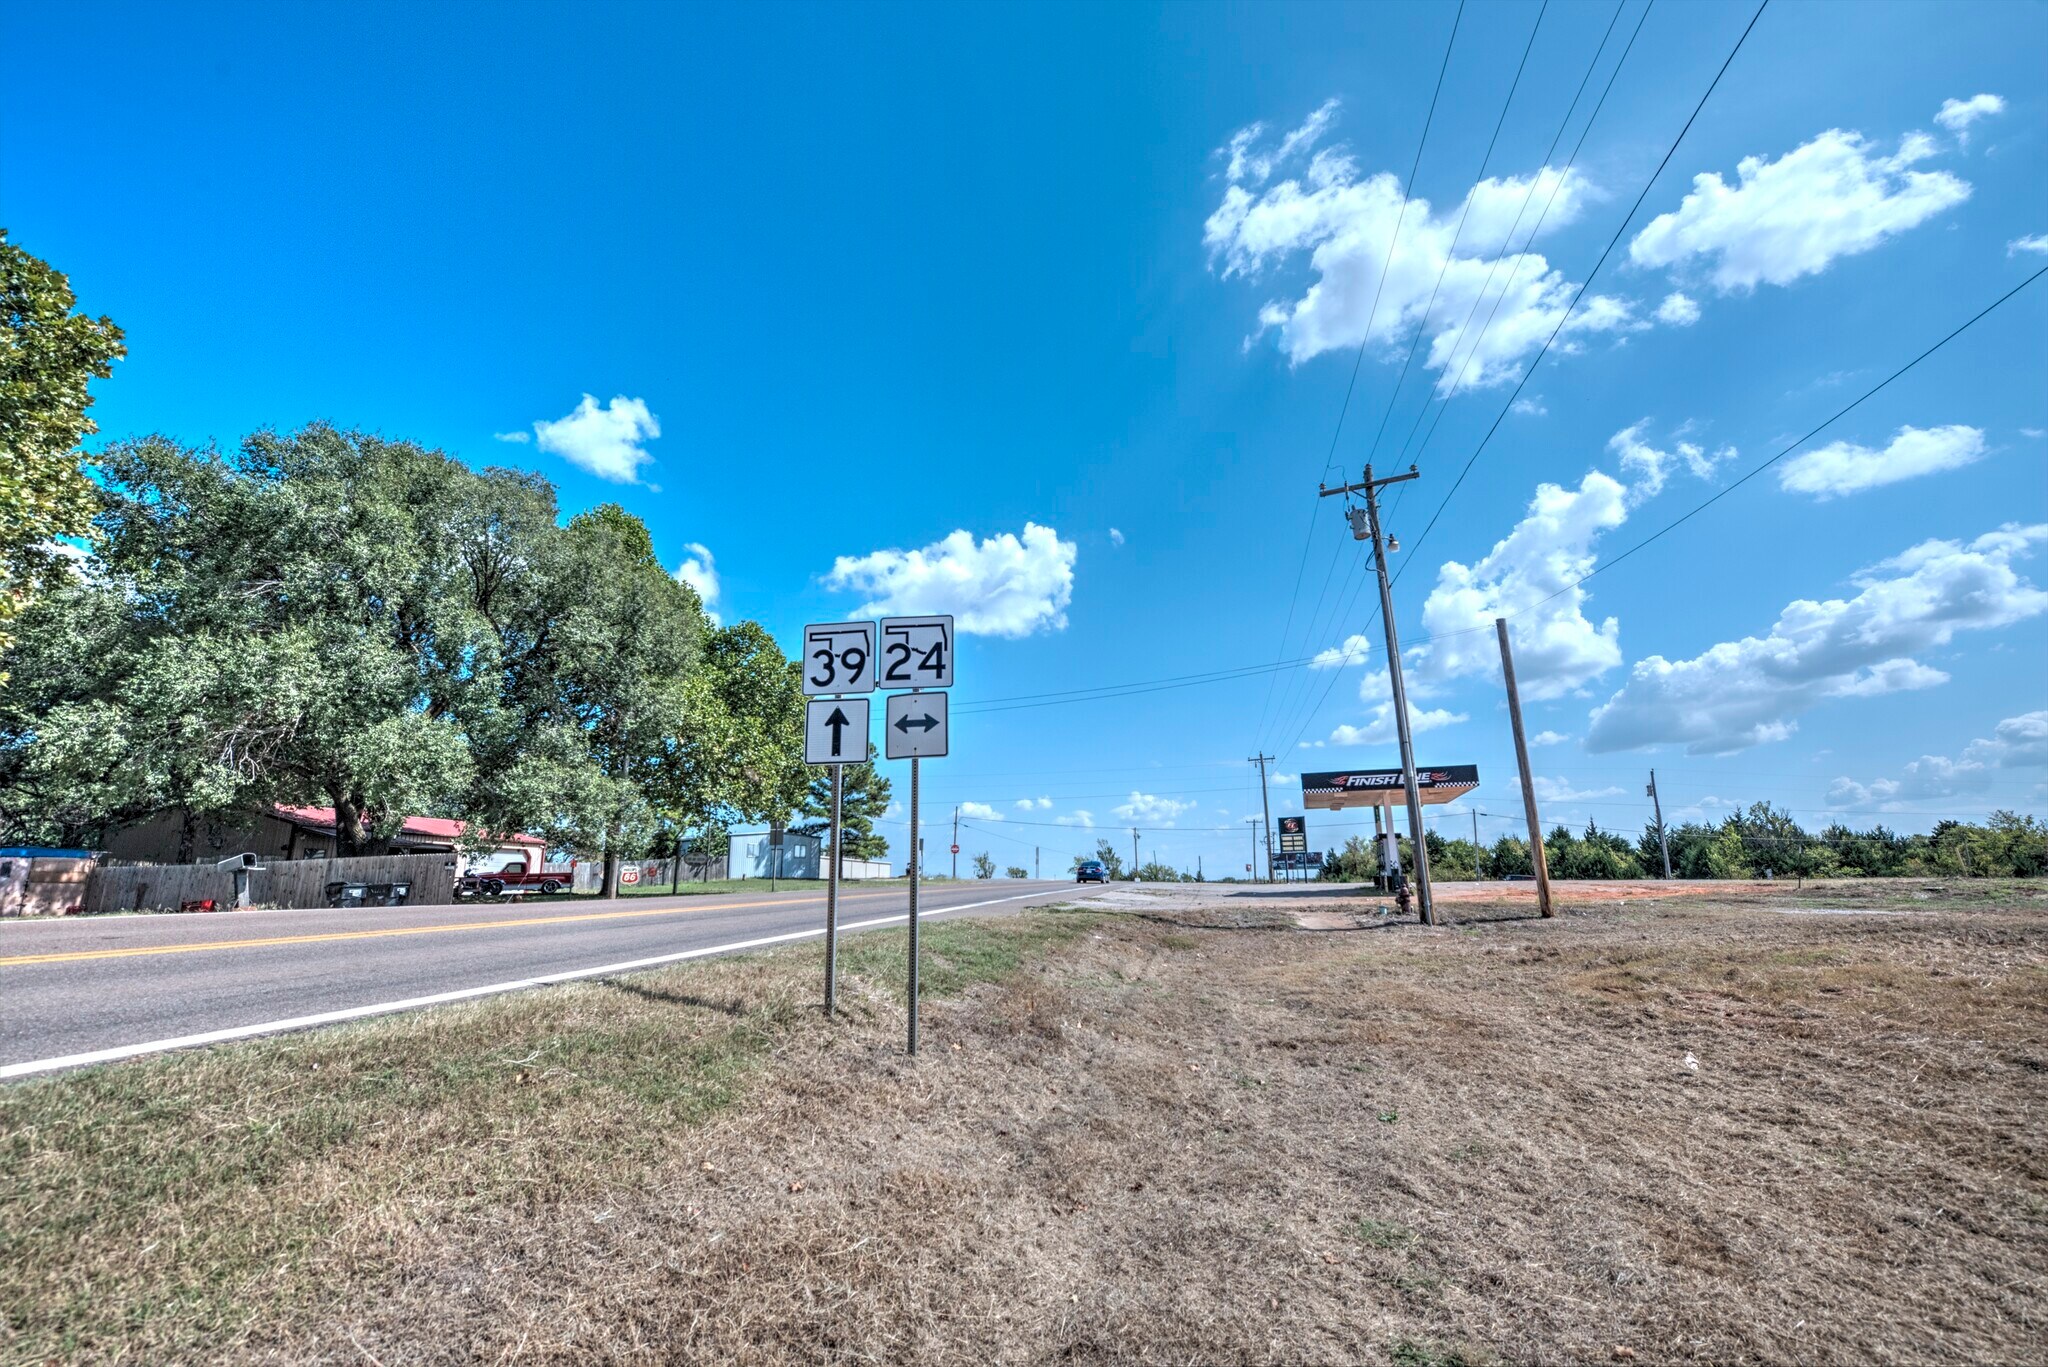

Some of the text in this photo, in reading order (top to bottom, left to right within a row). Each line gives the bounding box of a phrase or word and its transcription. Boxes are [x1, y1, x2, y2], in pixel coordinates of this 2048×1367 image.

[810, 647, 866, 687] 39
[885, 641, 946, 681] 24
[1346, 772, 1431, 786] FINISH LNE
[624, 873, 636, 881] 66
